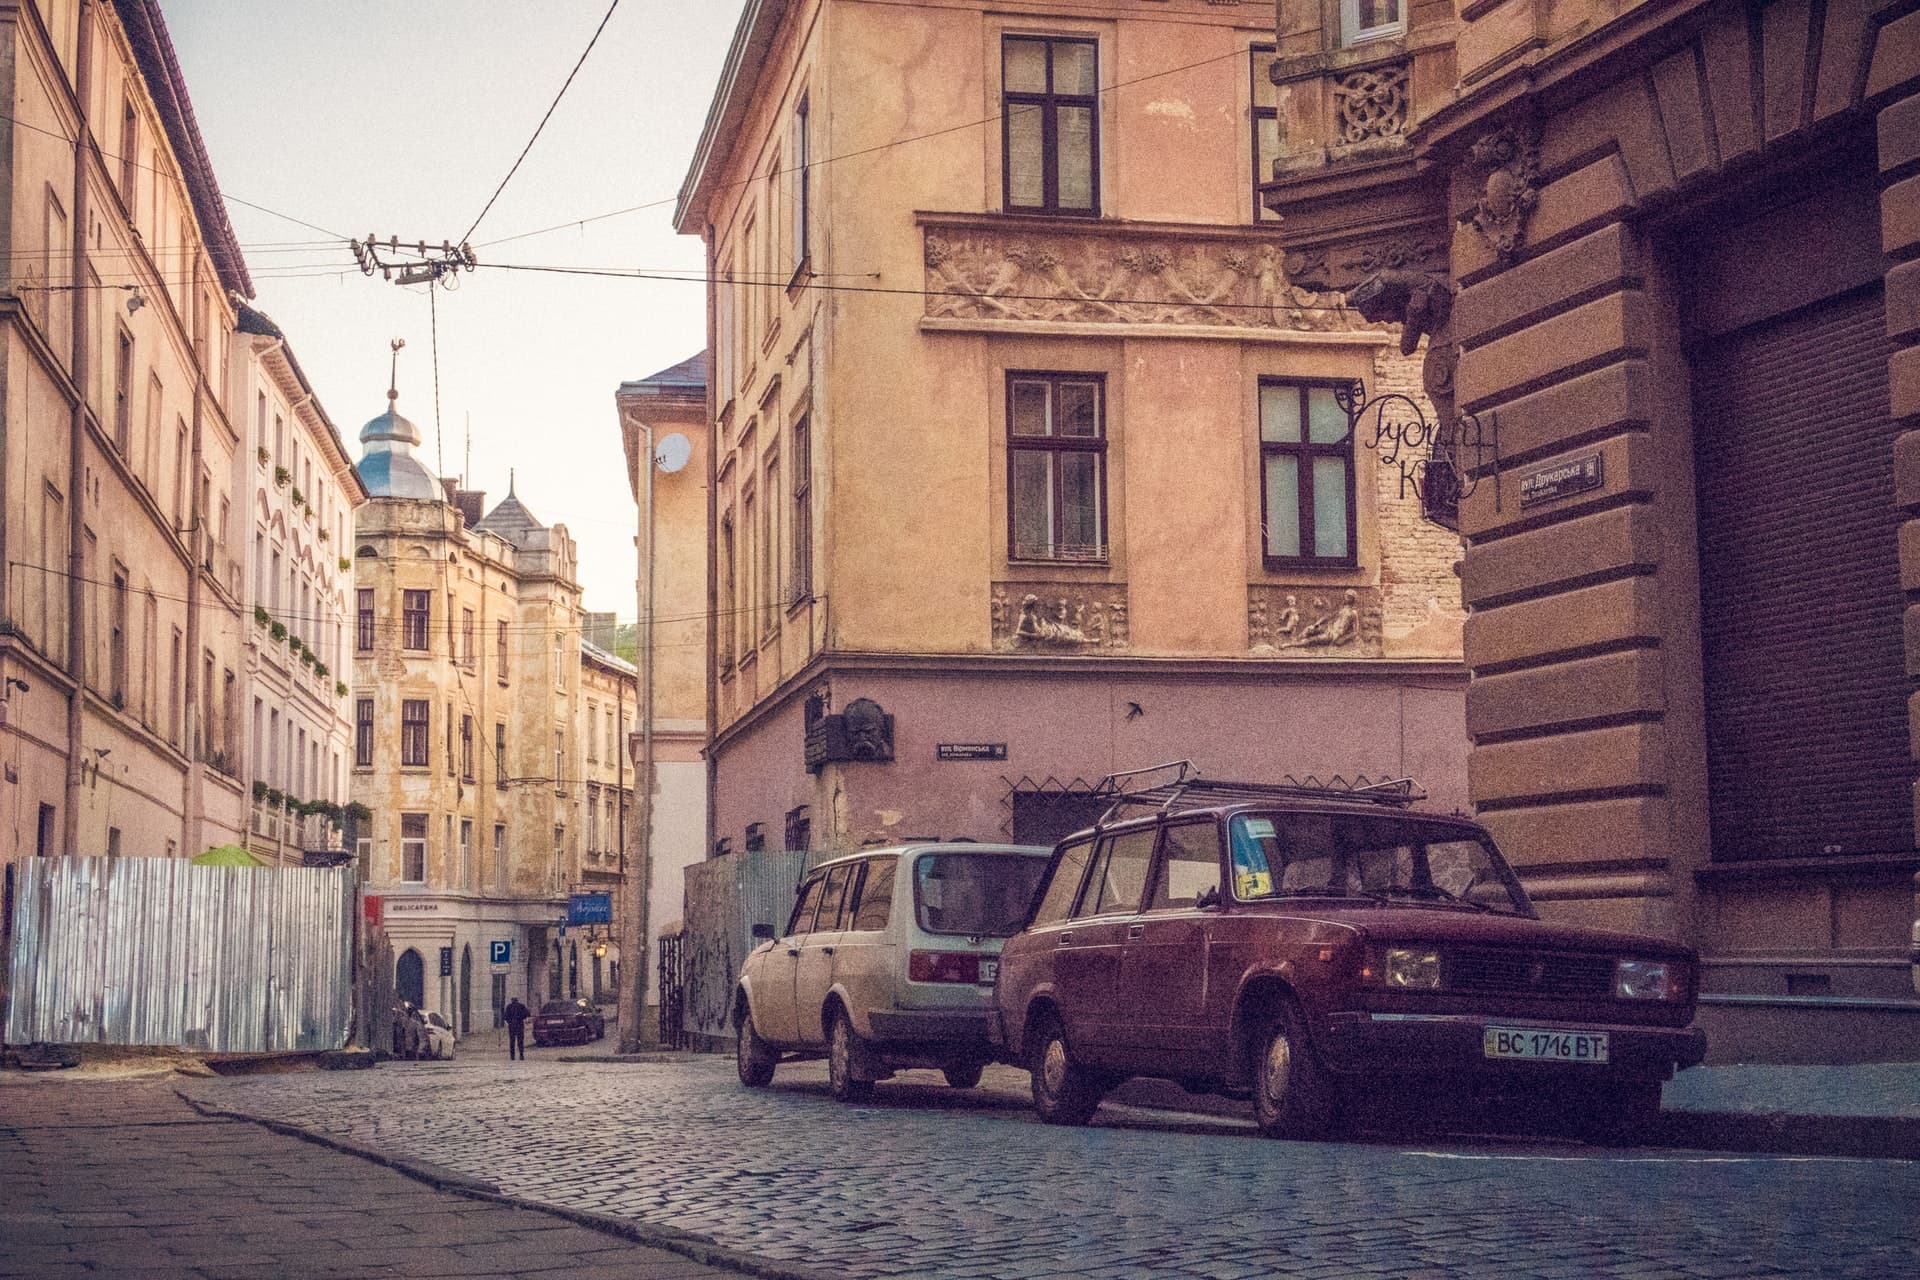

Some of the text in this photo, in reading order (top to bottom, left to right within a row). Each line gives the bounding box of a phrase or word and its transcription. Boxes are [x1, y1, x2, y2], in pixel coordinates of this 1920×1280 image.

[1535, 464, 1581, 489] Друкарська
[494, 943, 506, 961] P
[1497, 1032, 1602, 1058] BC 1716 BT
